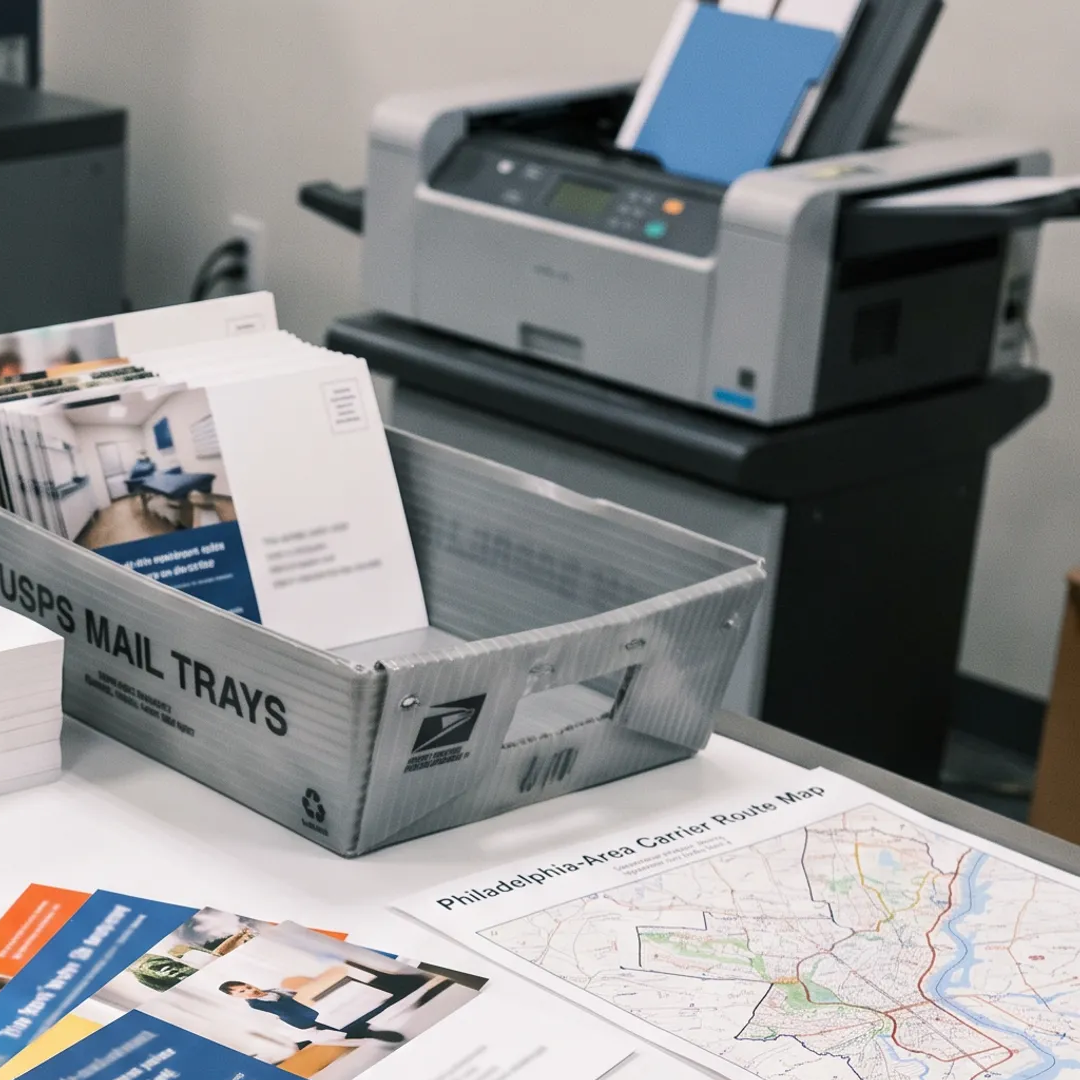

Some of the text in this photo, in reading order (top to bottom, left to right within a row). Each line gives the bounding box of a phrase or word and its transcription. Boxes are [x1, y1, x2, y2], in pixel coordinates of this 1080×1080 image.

[84, 608, 165, 681] MAIL
[170, 649, 289, 738] TRAYS
[435, 844, 636, 912] Philadelphia-Area
[636, 820, 712, 850] Carrier
[710, 801, 778, 827] Route
[775, 785, 826, 806] Map
